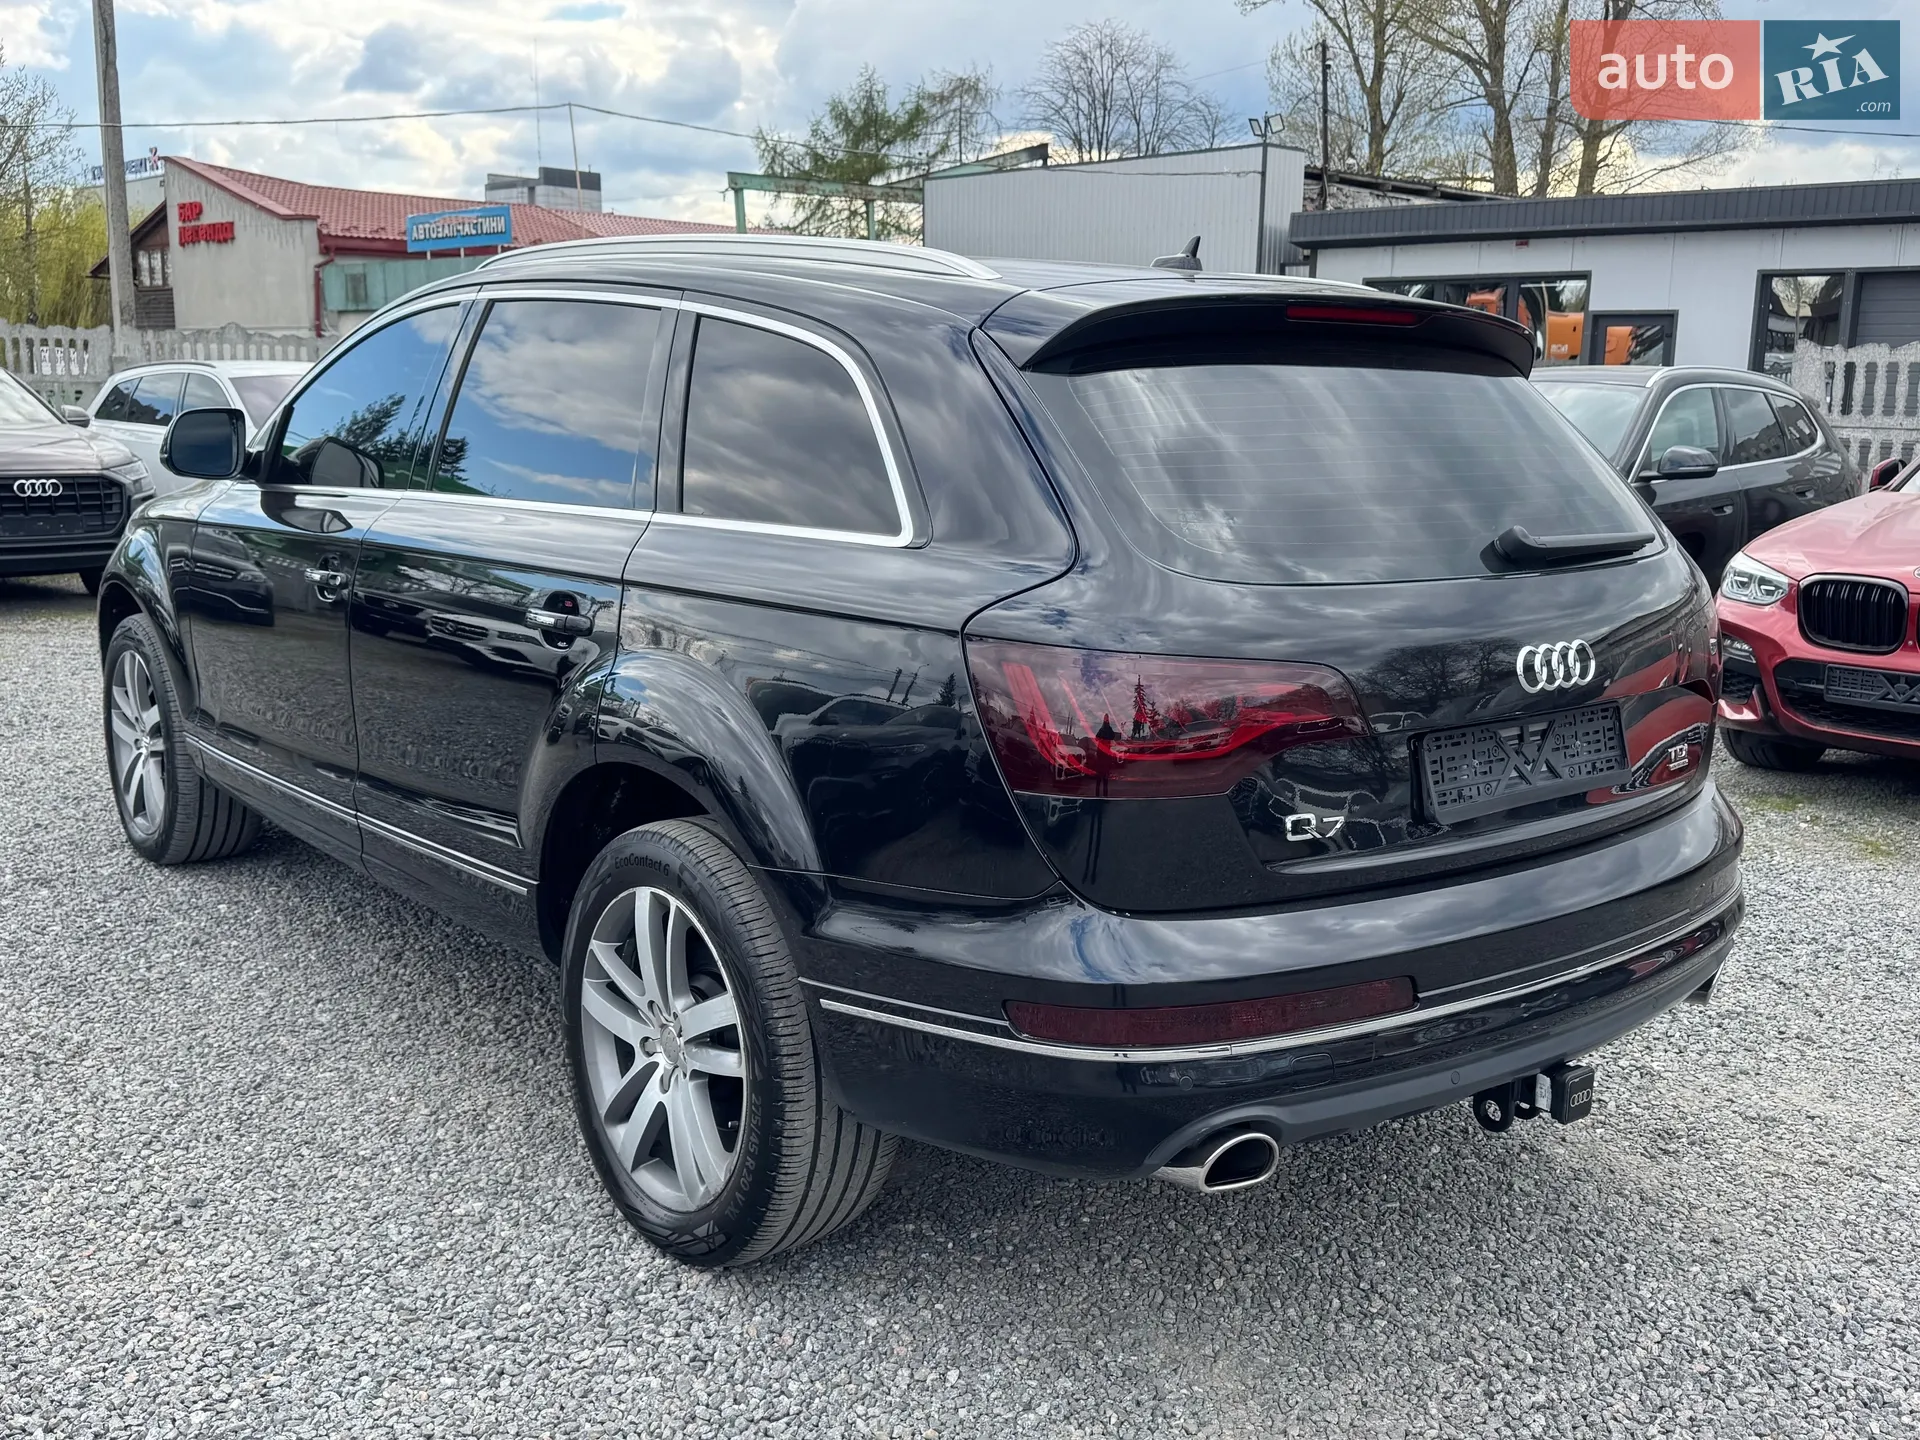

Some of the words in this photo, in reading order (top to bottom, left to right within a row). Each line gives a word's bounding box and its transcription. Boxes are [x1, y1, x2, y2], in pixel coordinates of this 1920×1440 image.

[177, 201, 203, 223] БАР
[412, 216, 505, 241] АВТОЗАПЧАСТИНИ
[1285, 813, 1345, 841] Q7
[614, 853, 662, 872] EcoContact
[663, 863, 670, 876] 6
[748, 1093, 762, 1155] 275/45
[740, 1156, 756, 1191] R20
